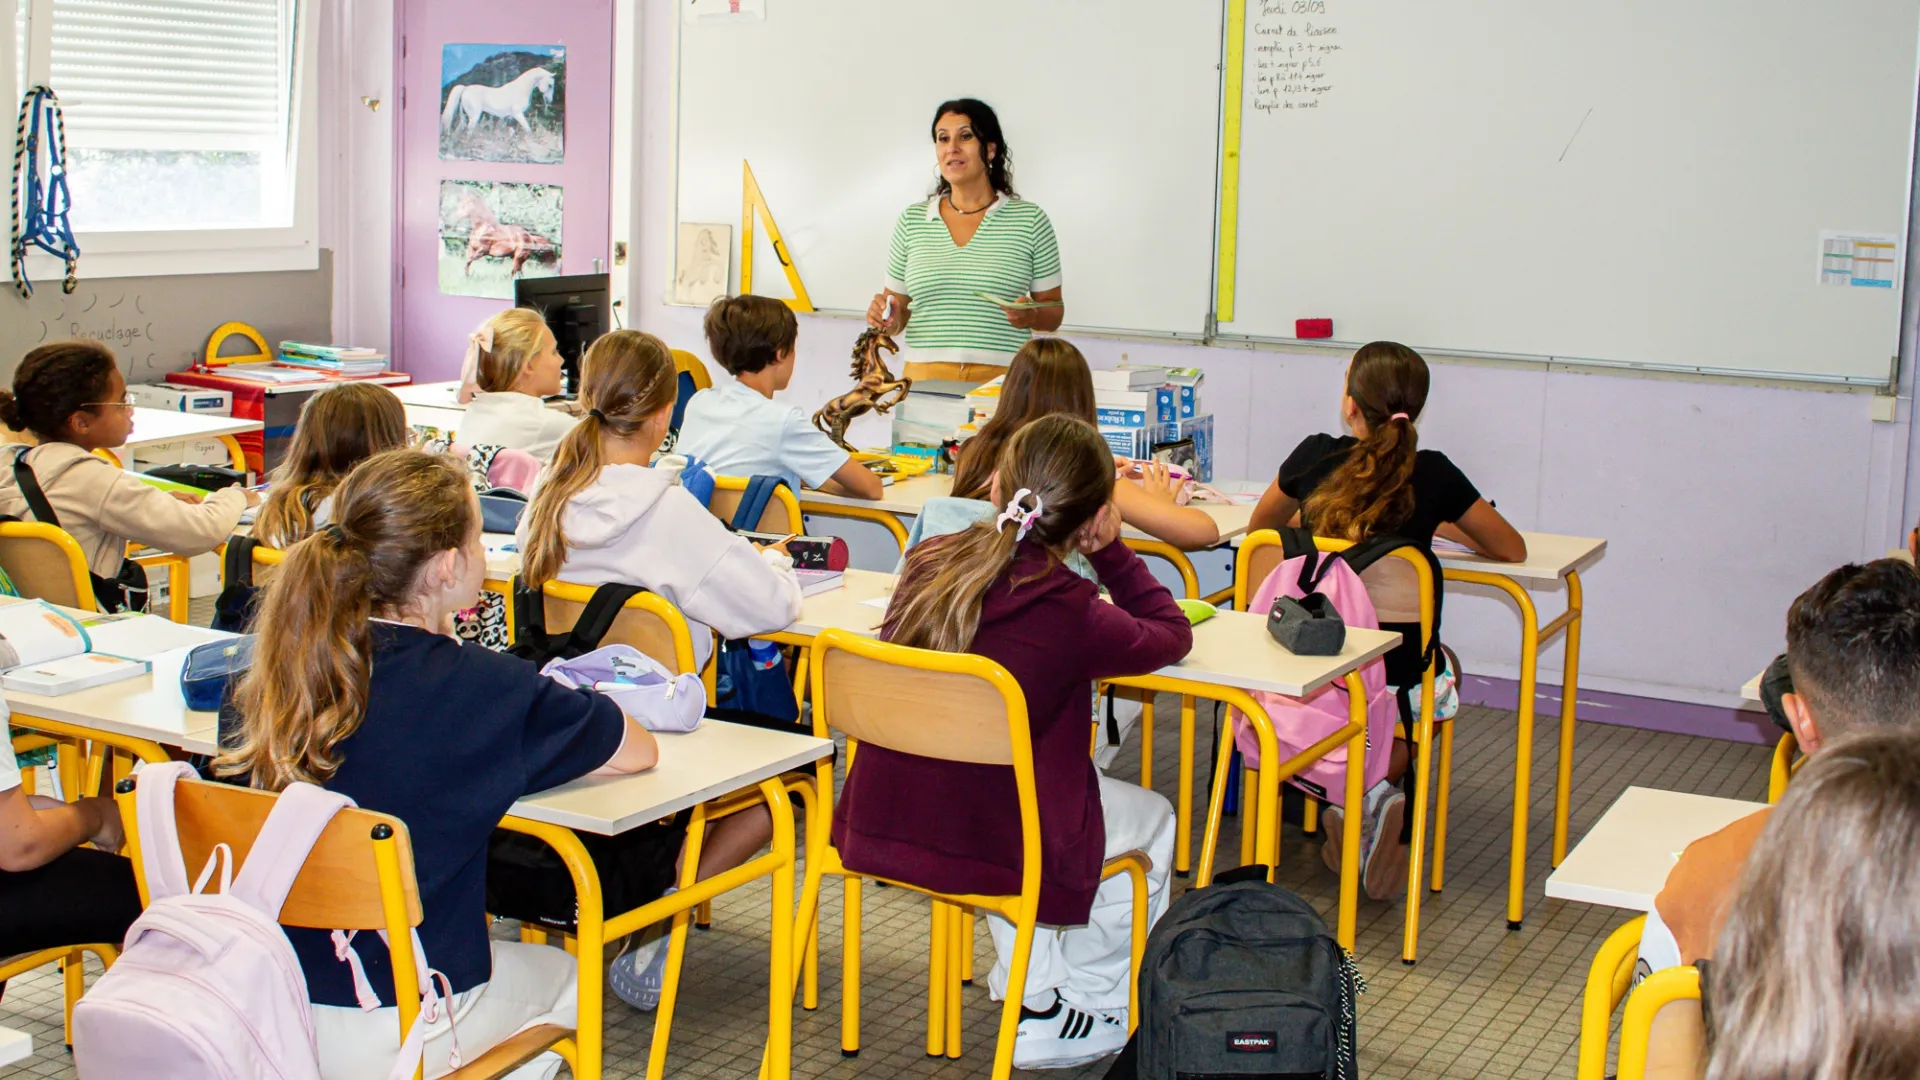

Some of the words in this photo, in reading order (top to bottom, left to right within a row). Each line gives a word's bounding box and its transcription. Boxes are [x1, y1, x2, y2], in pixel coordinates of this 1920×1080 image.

[1254, 23, 1282, 35] Carnet
[1286, 25, 1298, 36] de
[1233, 1038, 1270, 1046] EASTPAK
